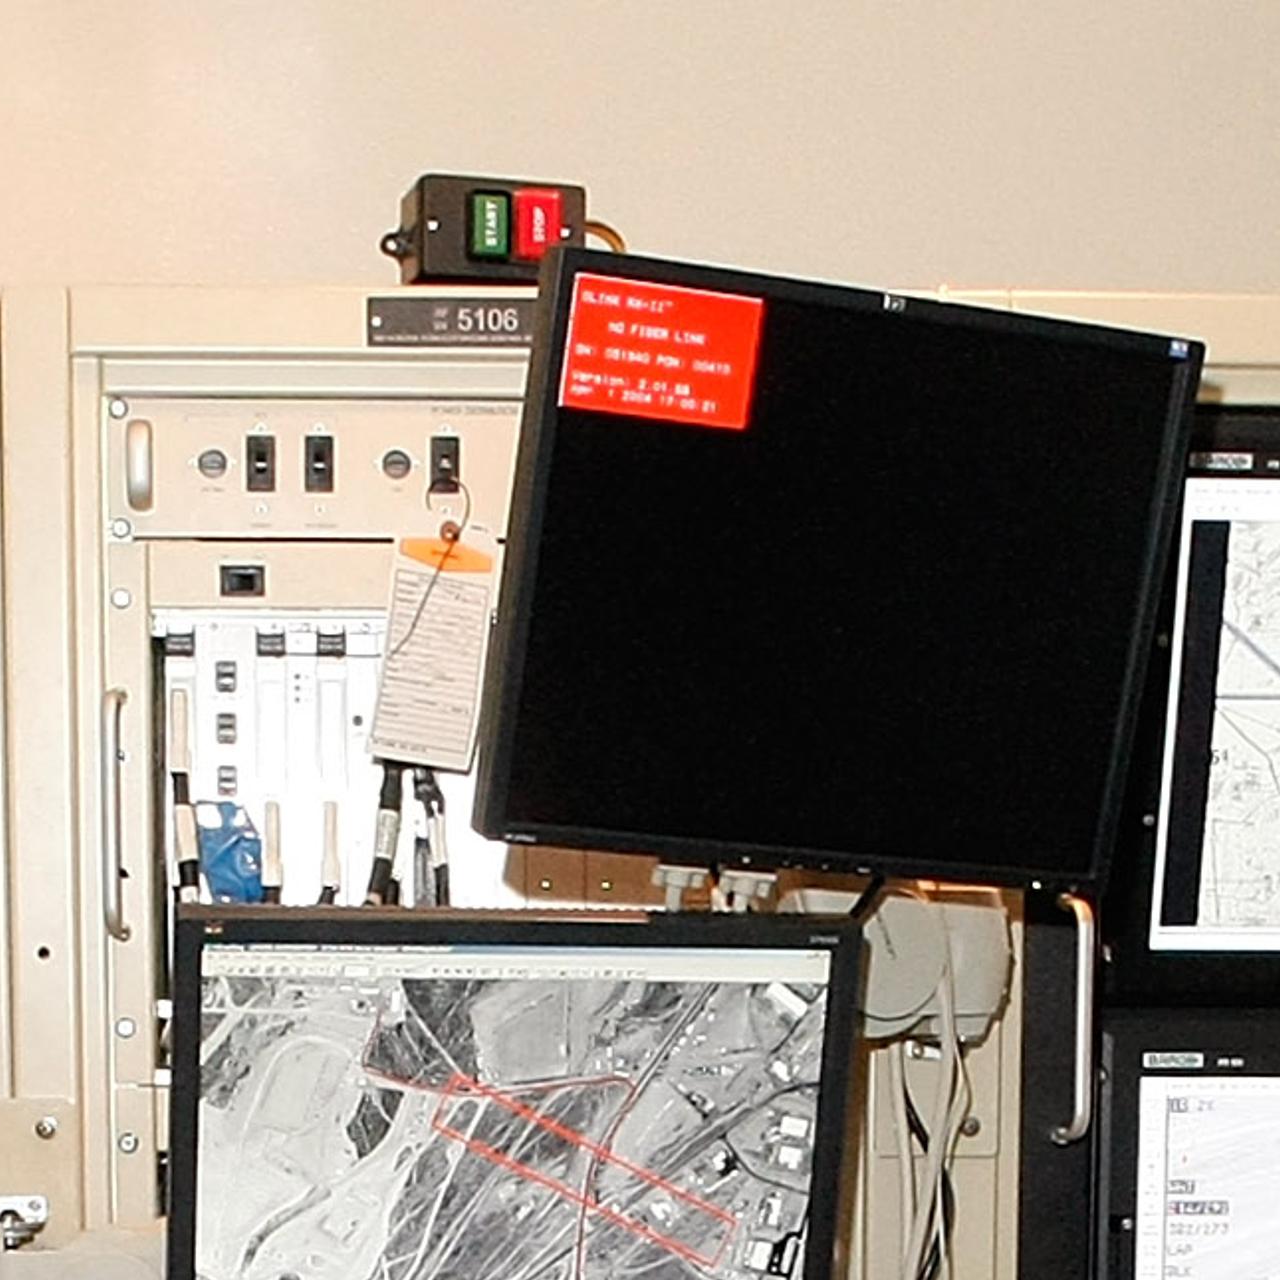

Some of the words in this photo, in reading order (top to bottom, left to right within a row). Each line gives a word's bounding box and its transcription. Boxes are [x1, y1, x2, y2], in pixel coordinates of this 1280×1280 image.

[485, 201, 498, 246] START
[533, 206, 546, 243] STOP
[457, 307, 519, 332] 5106
